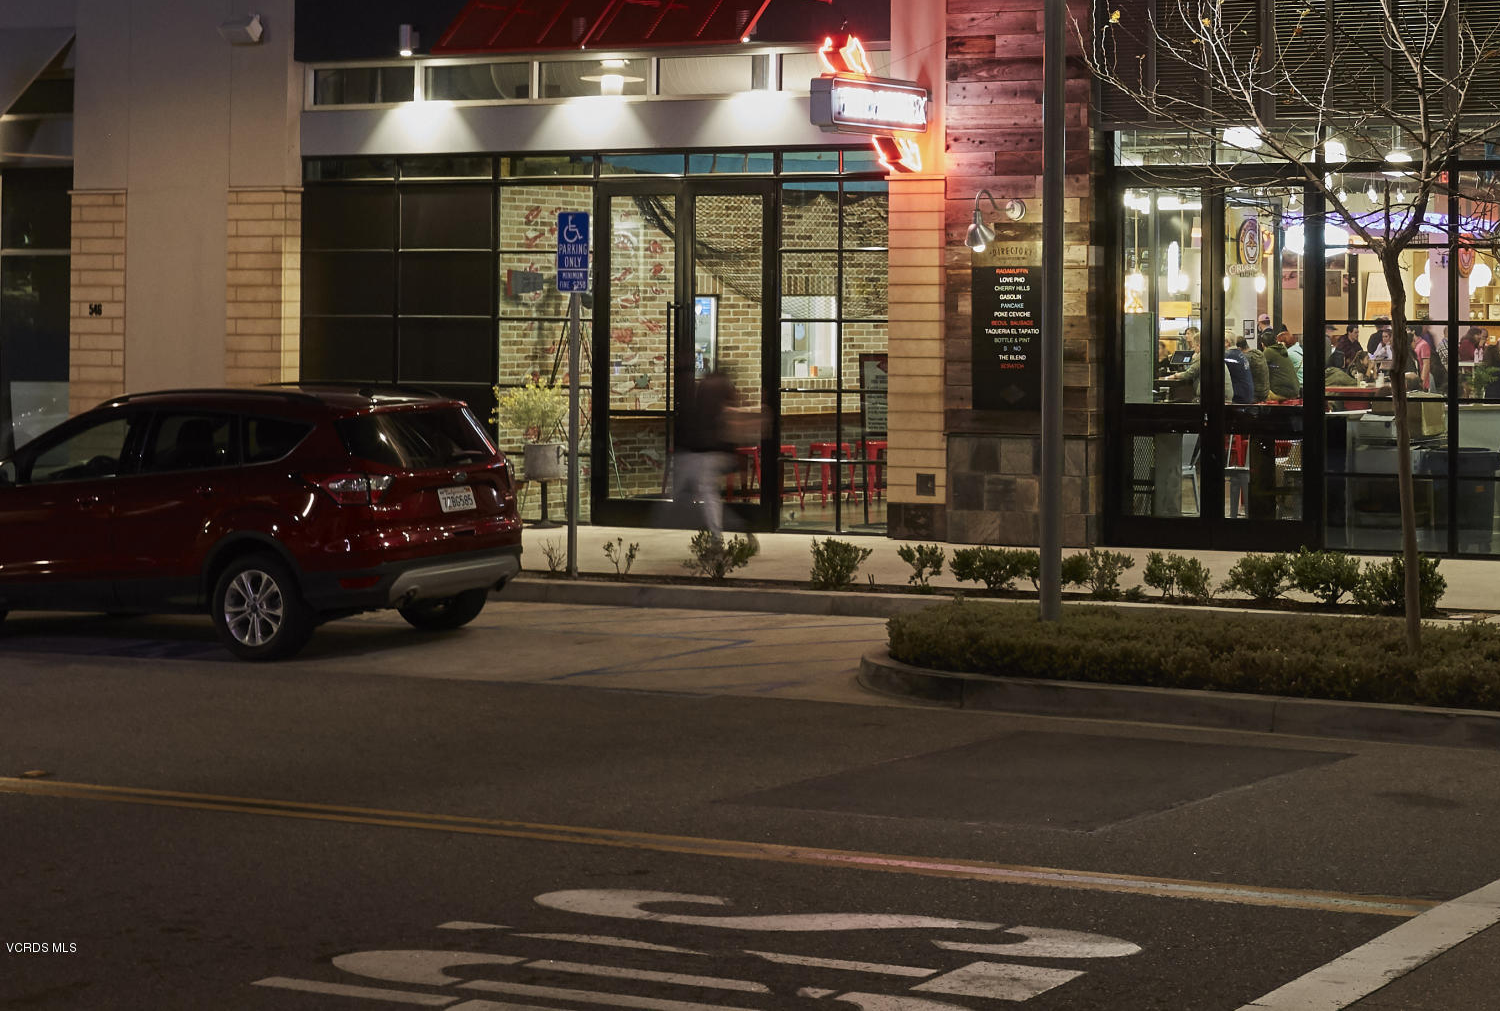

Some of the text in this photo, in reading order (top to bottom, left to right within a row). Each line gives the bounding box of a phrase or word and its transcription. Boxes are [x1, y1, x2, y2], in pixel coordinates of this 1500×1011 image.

[558, 243, 588, 255] PARKING
[992, 246, 1033, 257] DIRECTORY
[564, 256, 582, 268] ONLY
[562, 271, 584, 279] MINIMUM
